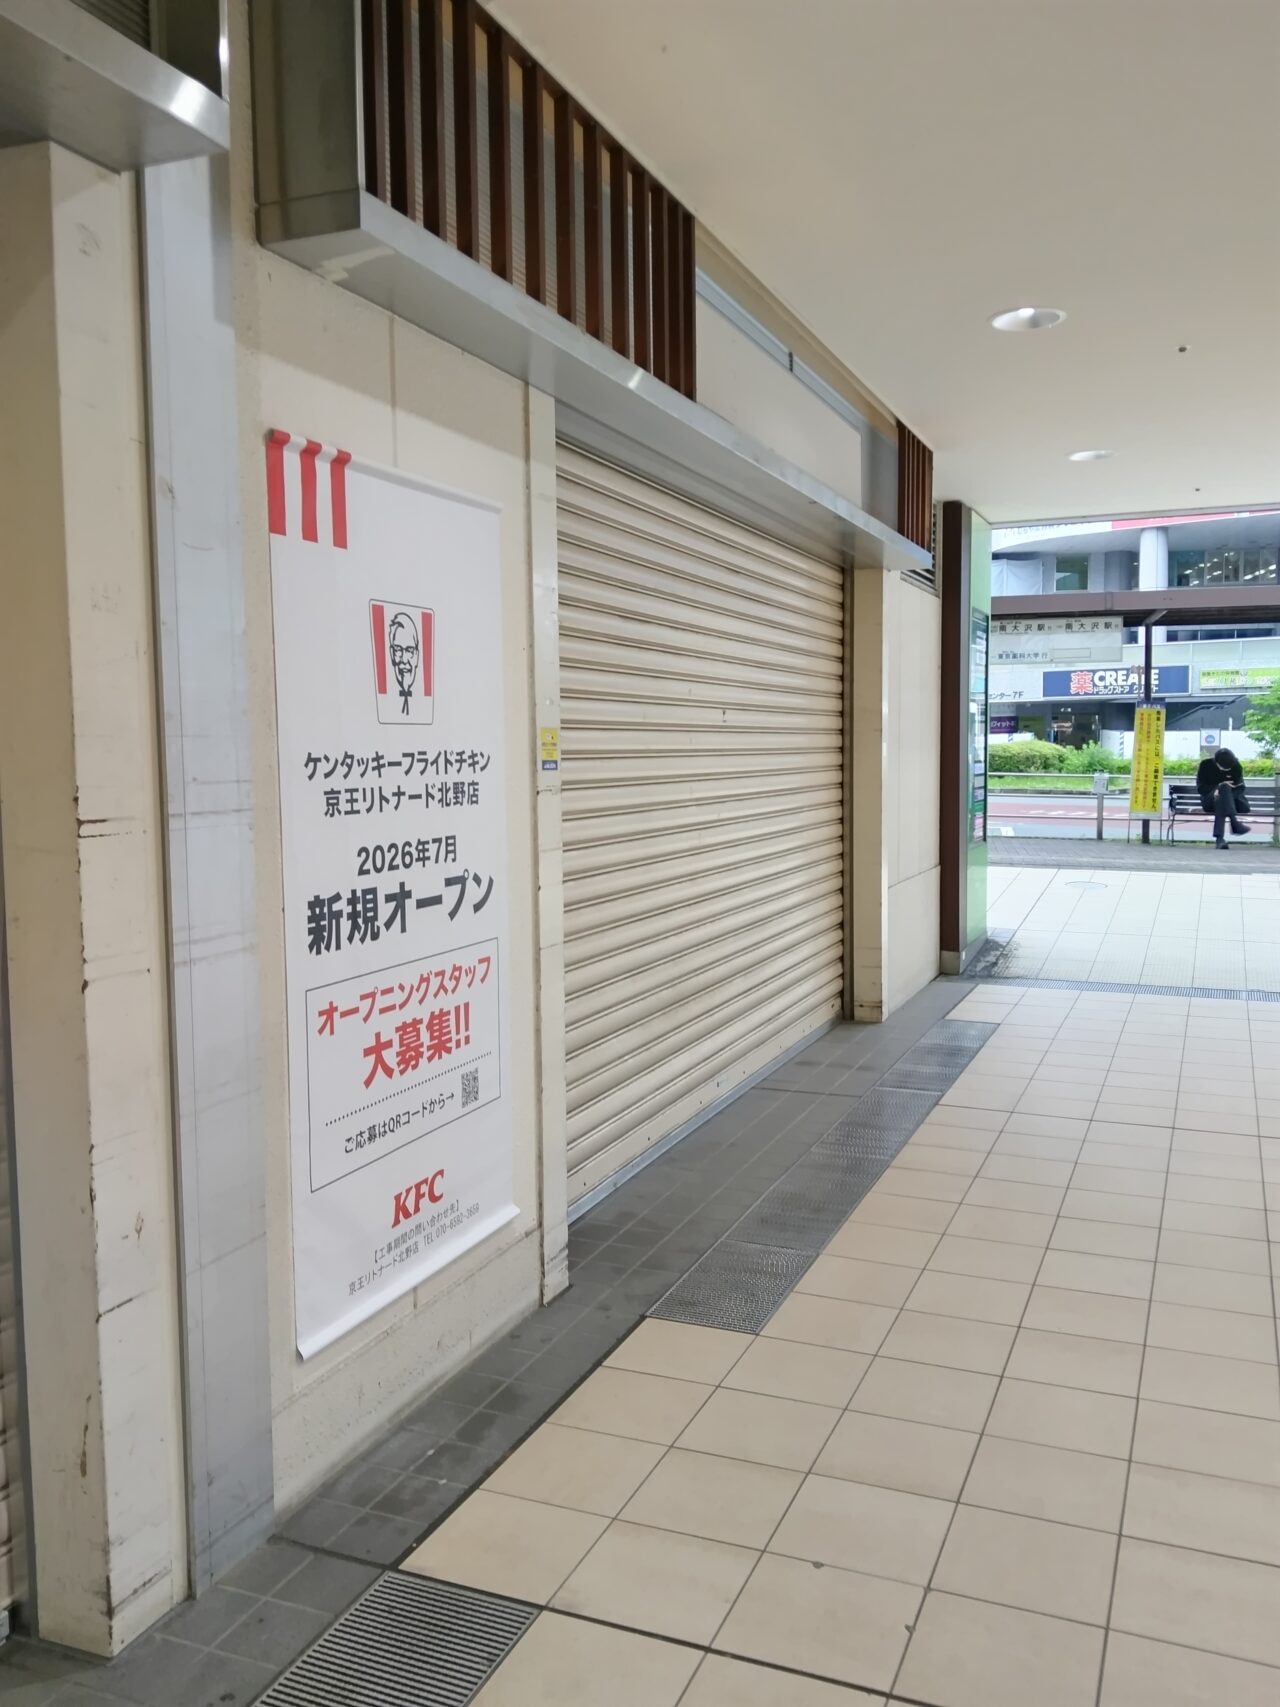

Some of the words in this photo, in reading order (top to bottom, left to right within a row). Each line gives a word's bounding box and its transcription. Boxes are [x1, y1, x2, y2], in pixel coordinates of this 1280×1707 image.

[1070, 671, 1093, 694] 薬
[304, 750, 491, 782] ケンタッキーフライドチキン
[323, 780, 480, 818] 京王リトナード北野店
[357, 835, 457, 876] 2026年7月
[307, 868, 494, 956] 新規オープン
[317, 956, 491, 1037] オープニングスタッフ
[391, 1168, 444, 1229] KFC
